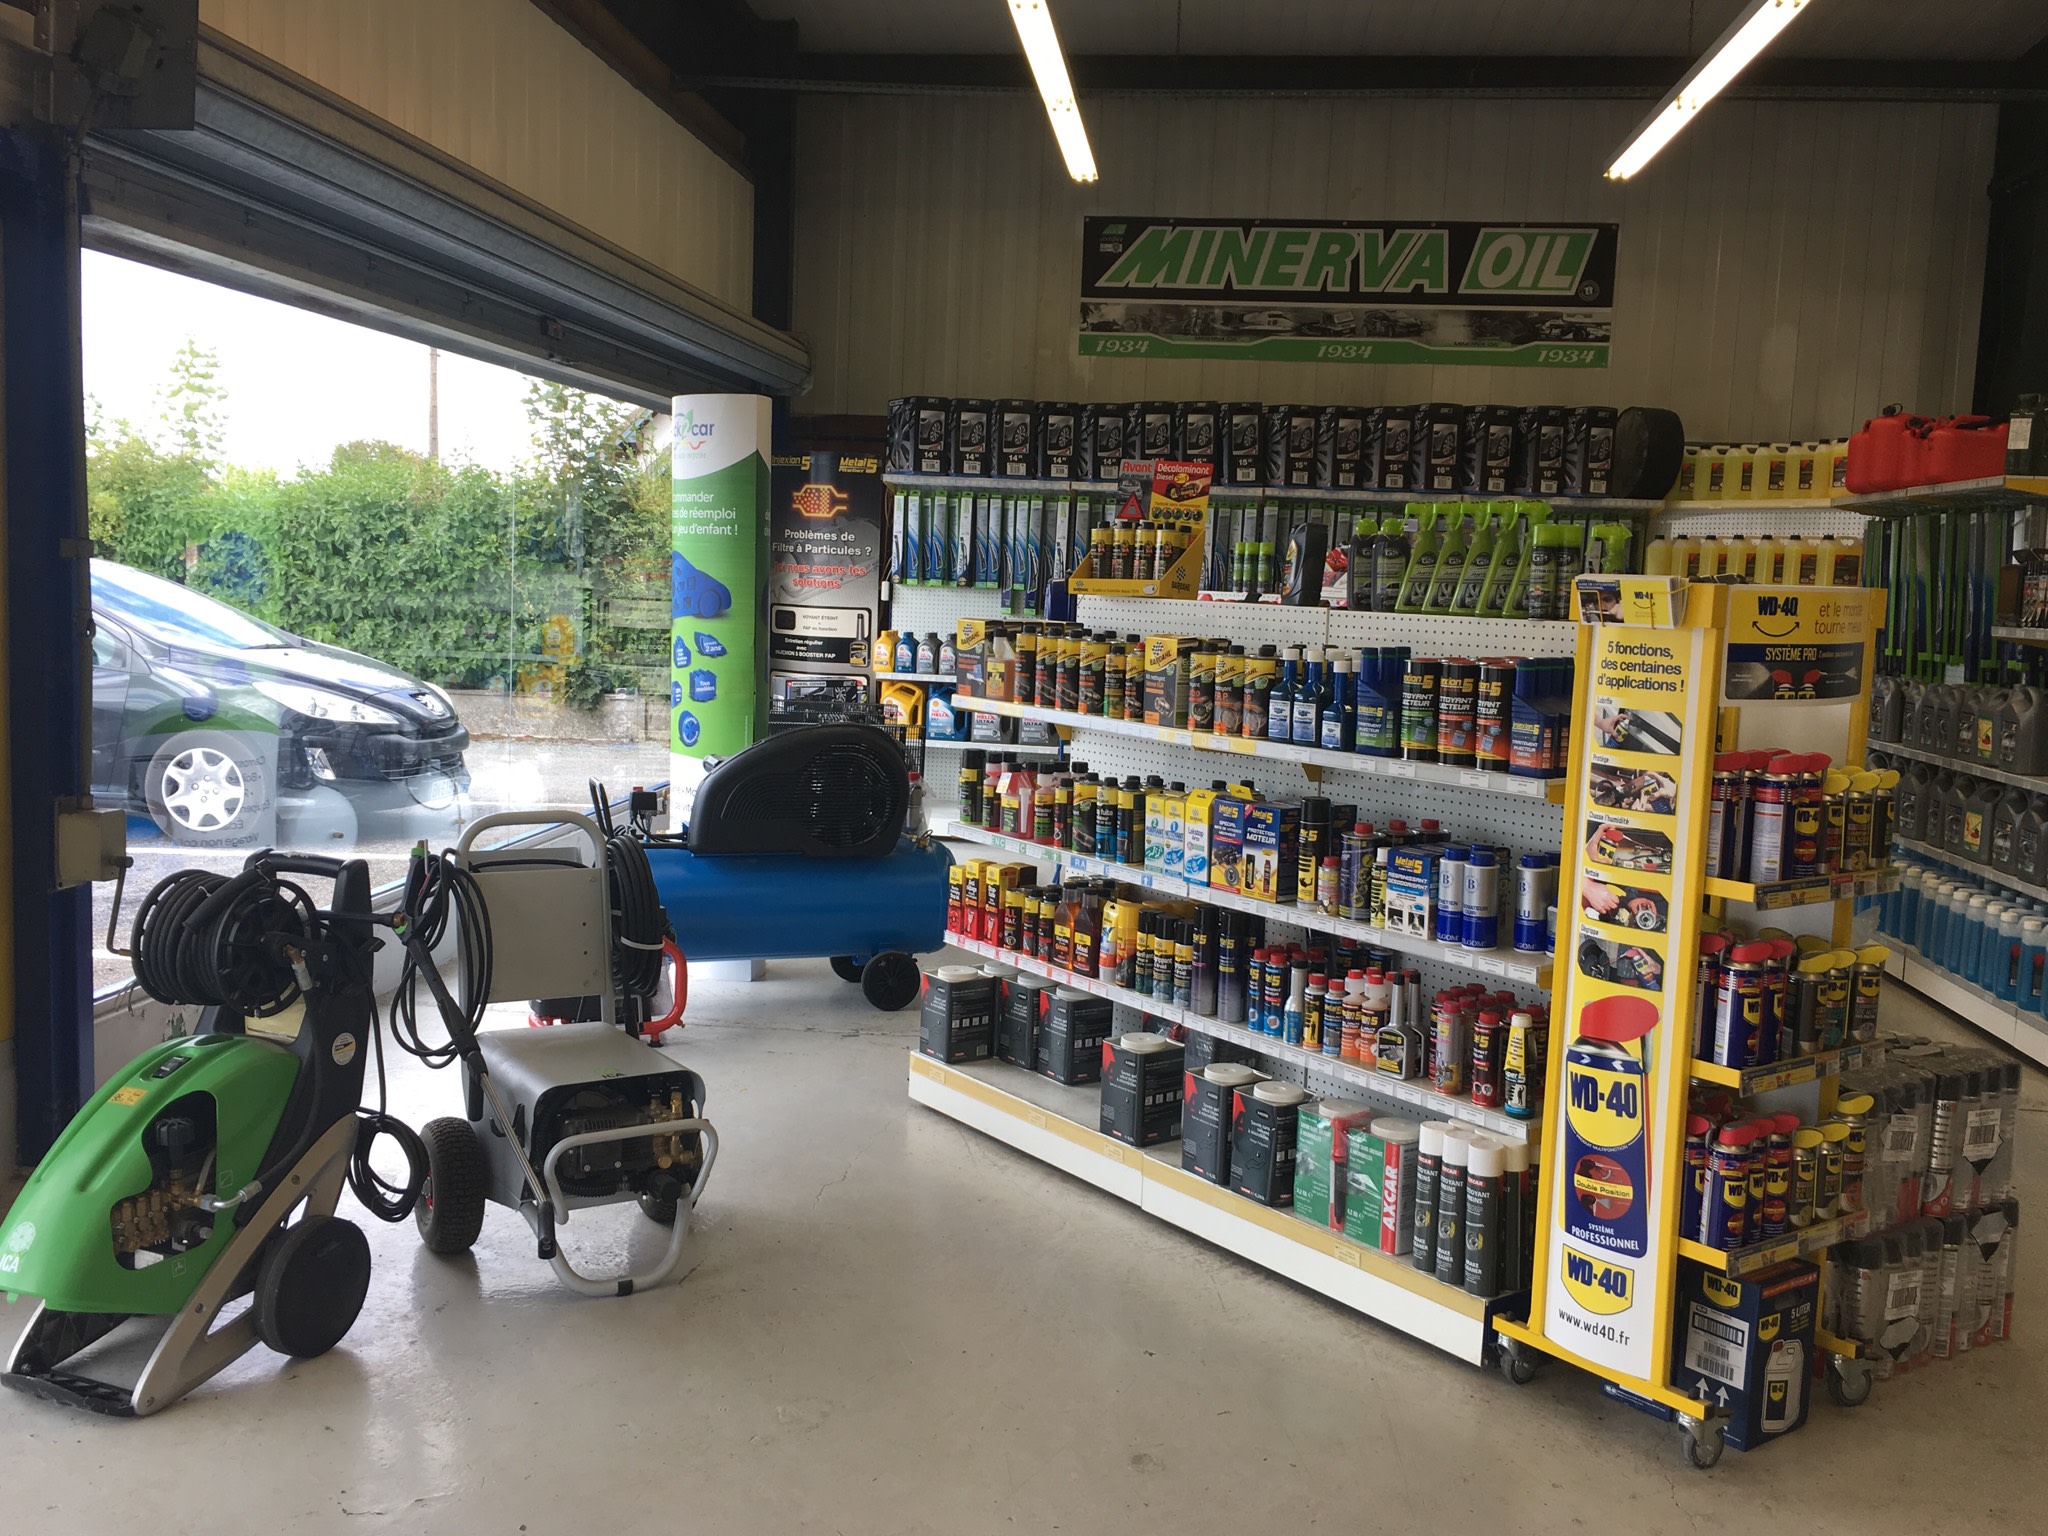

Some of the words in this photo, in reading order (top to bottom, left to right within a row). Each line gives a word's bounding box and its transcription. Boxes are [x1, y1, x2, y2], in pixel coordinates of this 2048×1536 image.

[1096, 226, 1450, 293] MINERVA
[1474, 230, 1580, 290] OIL
[1095, 338, 1150, 354] 1934
[1317, 344, 1373, 359] 1934
[1538, 348, 1595, 364] 1934
[1122, 461, 1152, 472] Avant
[1157, 463, 1210, 475] Décolaminant
[1156, 473, 1174, 481] Diesel
[689, 507, 736, 521] réemploi
[690, 524, 731, 535] d'enfant
[785, 529, 837, 541] Problèmes
[841, 530, 855, 541] de
[772, 543, 794, 552] Filtre
[797, 543, 802, 553] à
[805, 544, 861, 555] Particules
[865, 547, 872, 556] ?
[787, 564, 810, 573] nous
[812, 566, 846, 576] avons
[849, 565, 867, 576] les
[792, 577, 841, 589] solutions
[1758, 596, 1798, 616] WD-40
[1820, 603, 1831, 617] et
[1833, 602, 1842, 617] le
[1815, 619, 1846, 635] tourne
[1608, 641, 1614, 653] 5
[1615, 642, 1674, 660] fonctions,
[1765, 645, 1802, 661] SYSTÈME
[1802, 647, 1817, 661] PRO
[1601, 657, 1618, 671] des
[1619, 660, 1682, 676] centaines
[1597, 674, 1677, 693] d'applications
[1679, 680, 1685, 693] !
[1246, 834, 1276, 844] MOTEUR
[1413, 860, 1423, 874] 5
[1570, 1071, 1638, 1119] WD-40
[1576, 1180, 1598, 1192] Double
[1600, 1186, 1631, 1198] Position
[1382, 1164, 1398, 1232] AXCAR
[1588, 1222, 1614, 1235] SYSTÈME
[1572, 1225, 1640, 1250] PROFESSIONNEL
[1567, 1252, 1628, 1299] WD-40
[1707, 1274, 1738, 1298] WD-40
[1796, 1303, 1811, 1318] LITER
[1559, 1309, 1630, 1346] www.wd40.fr
